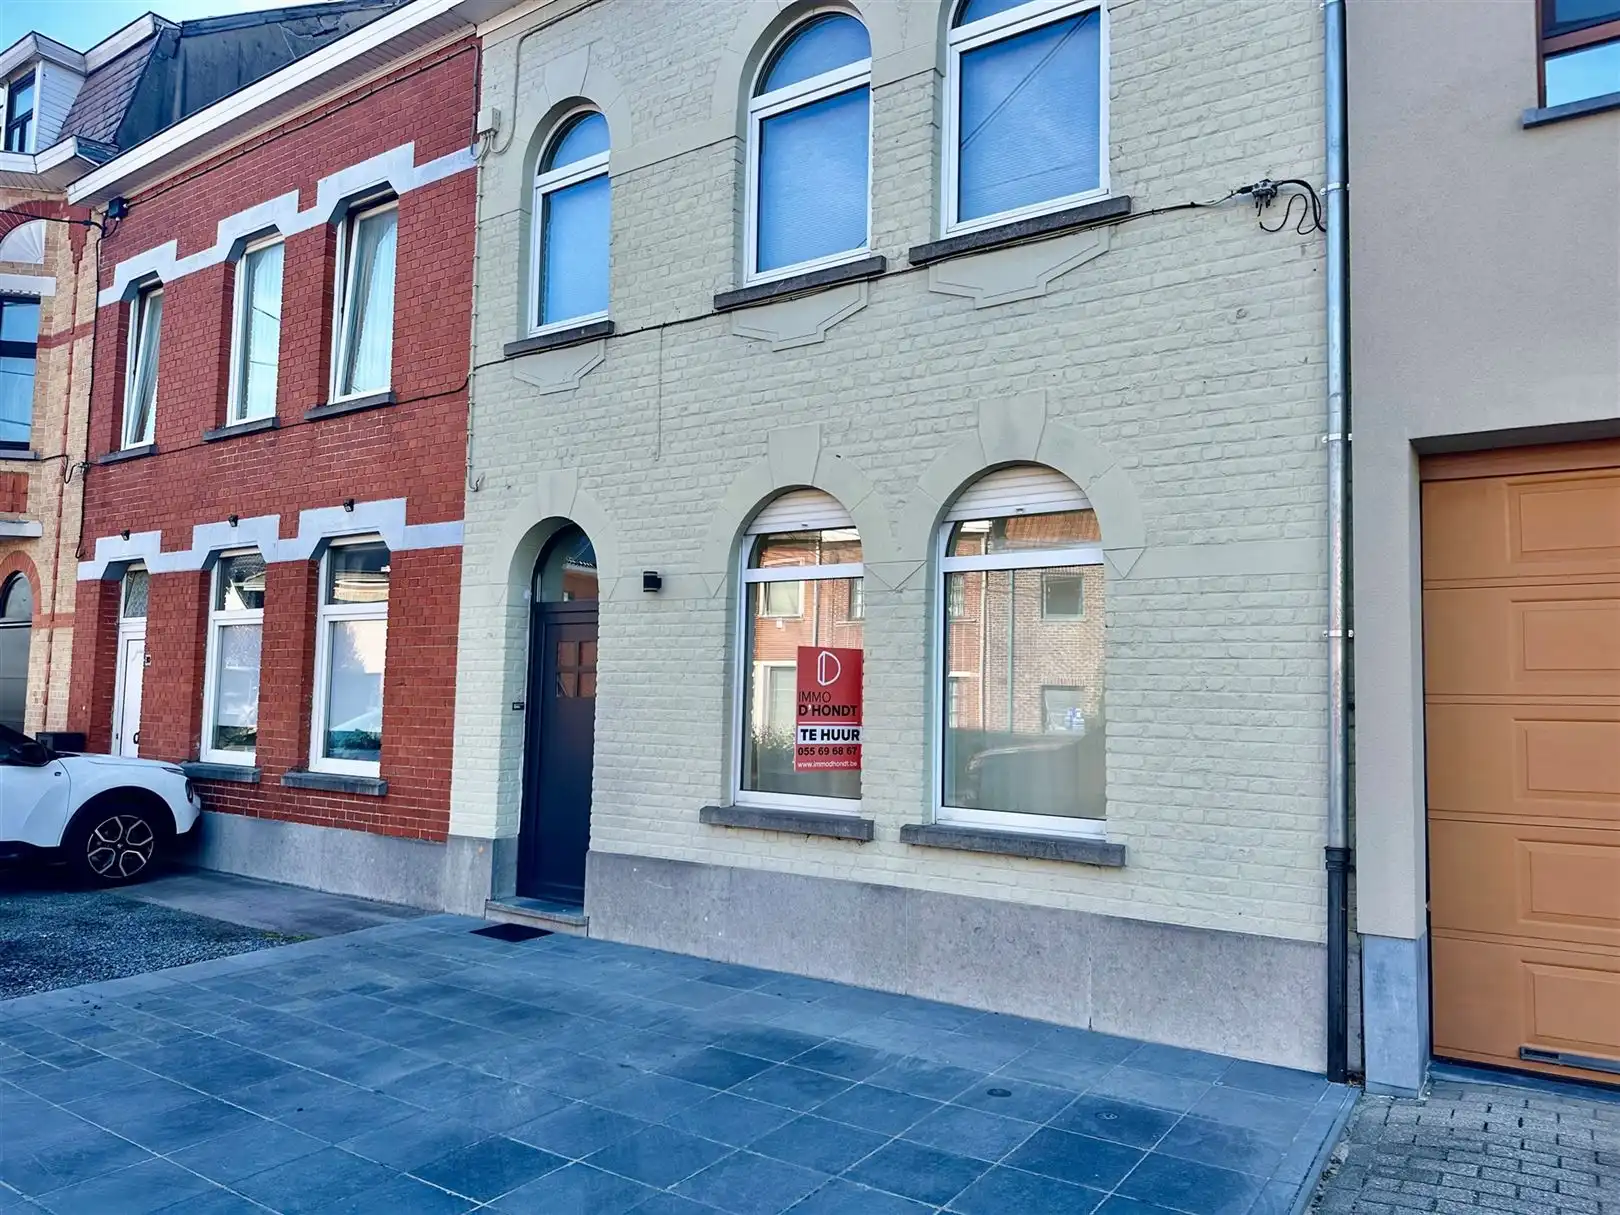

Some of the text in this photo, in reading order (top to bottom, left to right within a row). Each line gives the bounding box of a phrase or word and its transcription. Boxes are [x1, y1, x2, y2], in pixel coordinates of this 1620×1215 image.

[798, 690, 832, 703] IMMO
[798, 704, 858, 717] D'HONDT
[800, 728, 861, 741] TE HUUR
[797, 746, 858, 756] 055 69 68 67
[797, 760, 858, 768] www.immodhondt.be
